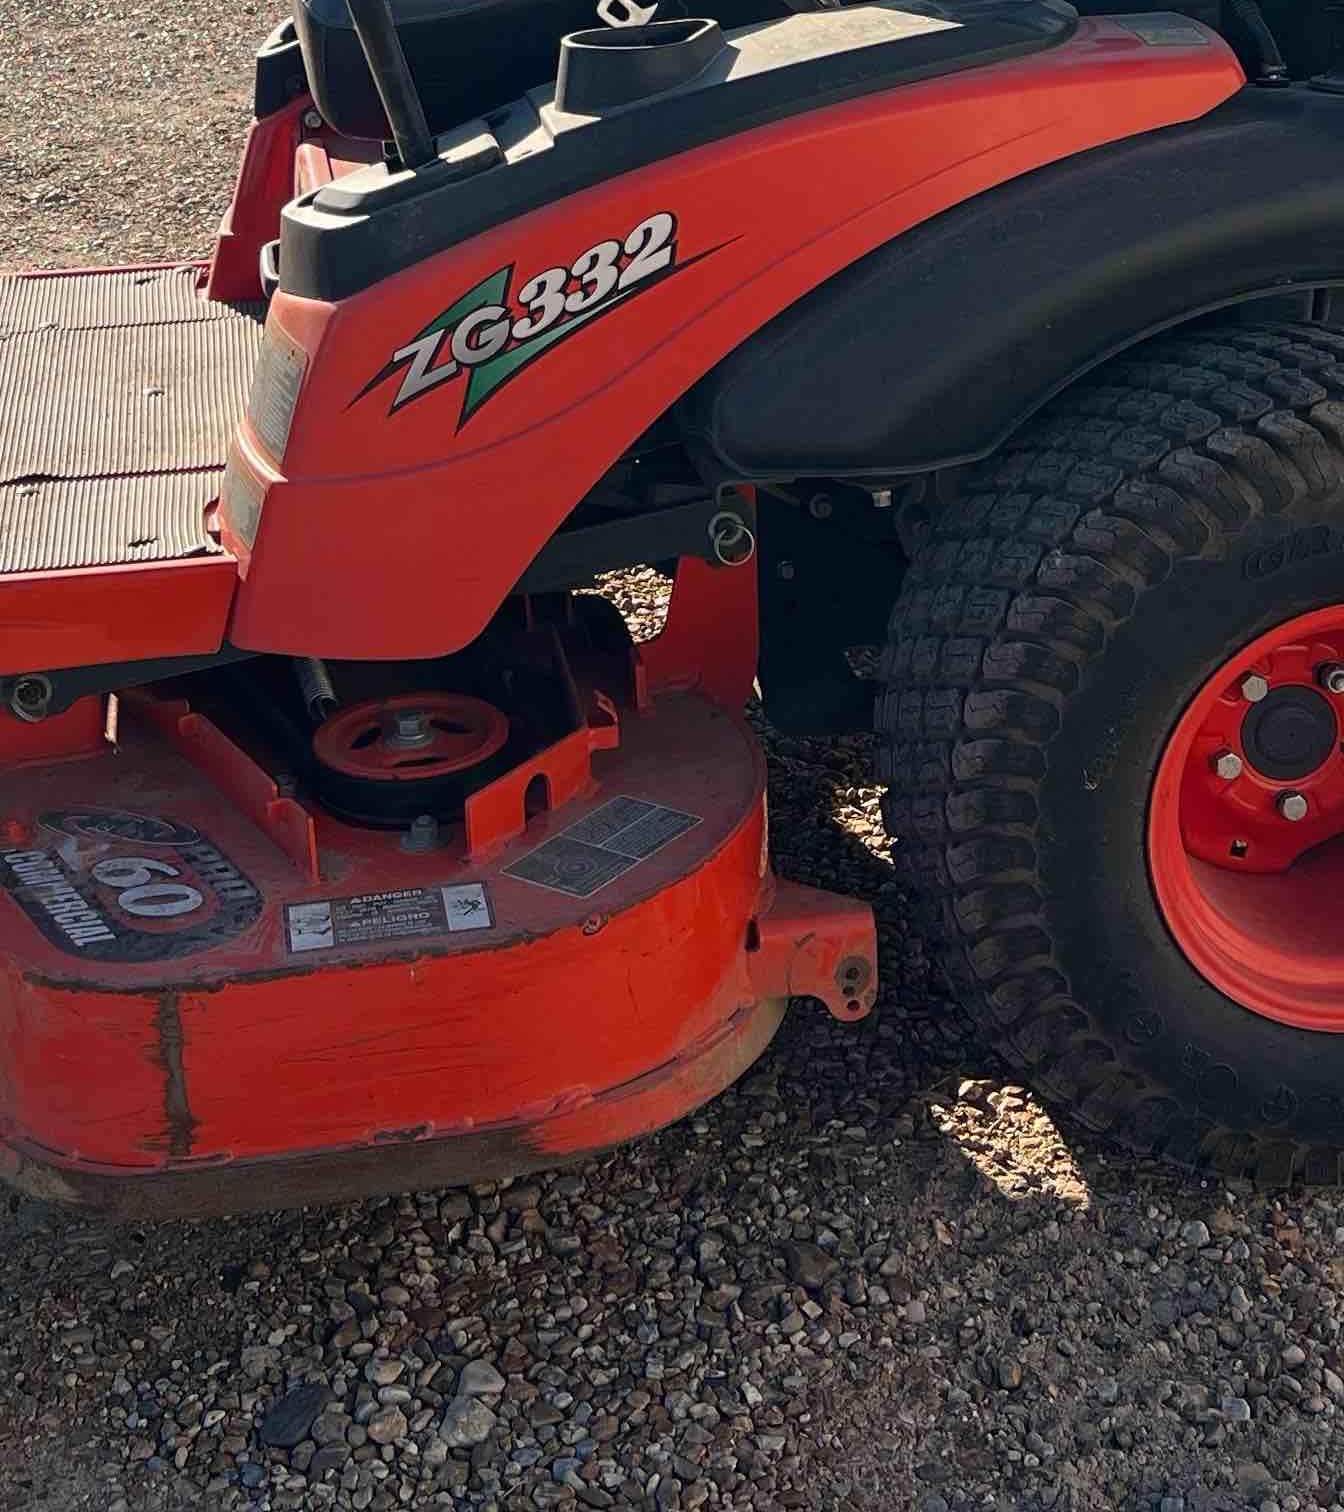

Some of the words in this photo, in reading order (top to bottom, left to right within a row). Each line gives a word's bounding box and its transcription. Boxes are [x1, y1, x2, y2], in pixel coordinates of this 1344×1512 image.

[391, 211, 677, 409] ZG332
[92, 856, 203, 917] 60
[362, 888, 422, 903] DANGER
[362, 911, 431, 928] PELIGRO
